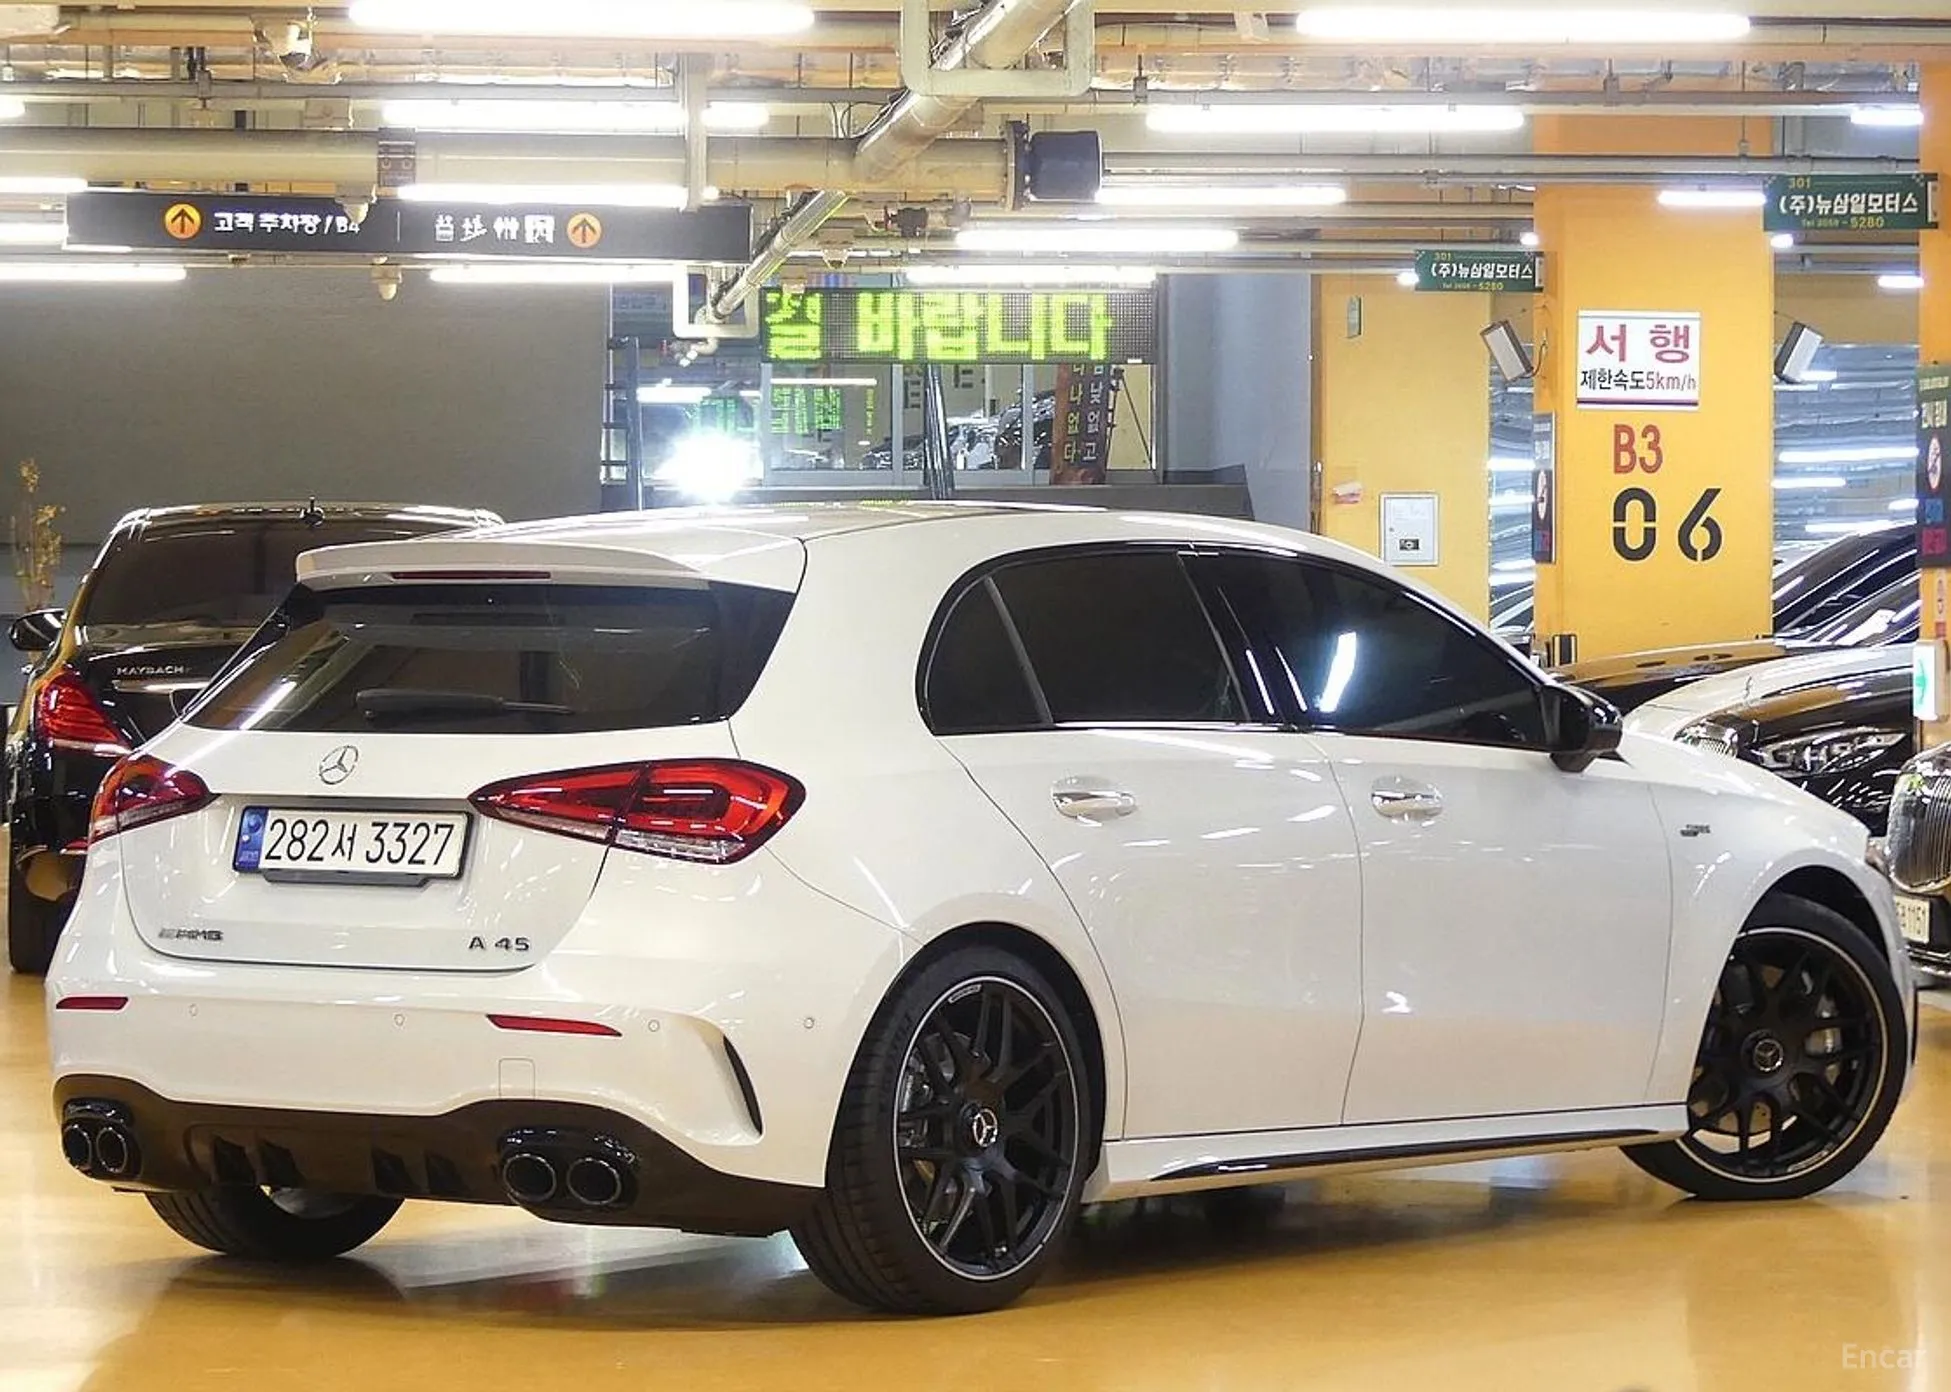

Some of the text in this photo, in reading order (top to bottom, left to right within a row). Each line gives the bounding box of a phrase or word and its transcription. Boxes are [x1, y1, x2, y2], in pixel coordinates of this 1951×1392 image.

[1788, 177, 1812, 189] 301
[1779, 192, 1920, 216] (주)뉴삼일모터스
[214, 211, 255, 233] 고객
[258, 211, 321, 235] 주차장
[1850, 215, 1886, 230] 5280
[1433, 251, 1452, 262] 301
[1430, 262, 1534, 280] (주)뉴삼일모터스
[857, 292, 1114, 360] 바랍니다
[1580, 367, 1697, 392] 제한속도5km/h
[1613, 423, 1664, 475] B3
[264, 818, 455, 865] 282서 3327
[469, 935, 530, 951] A 45
